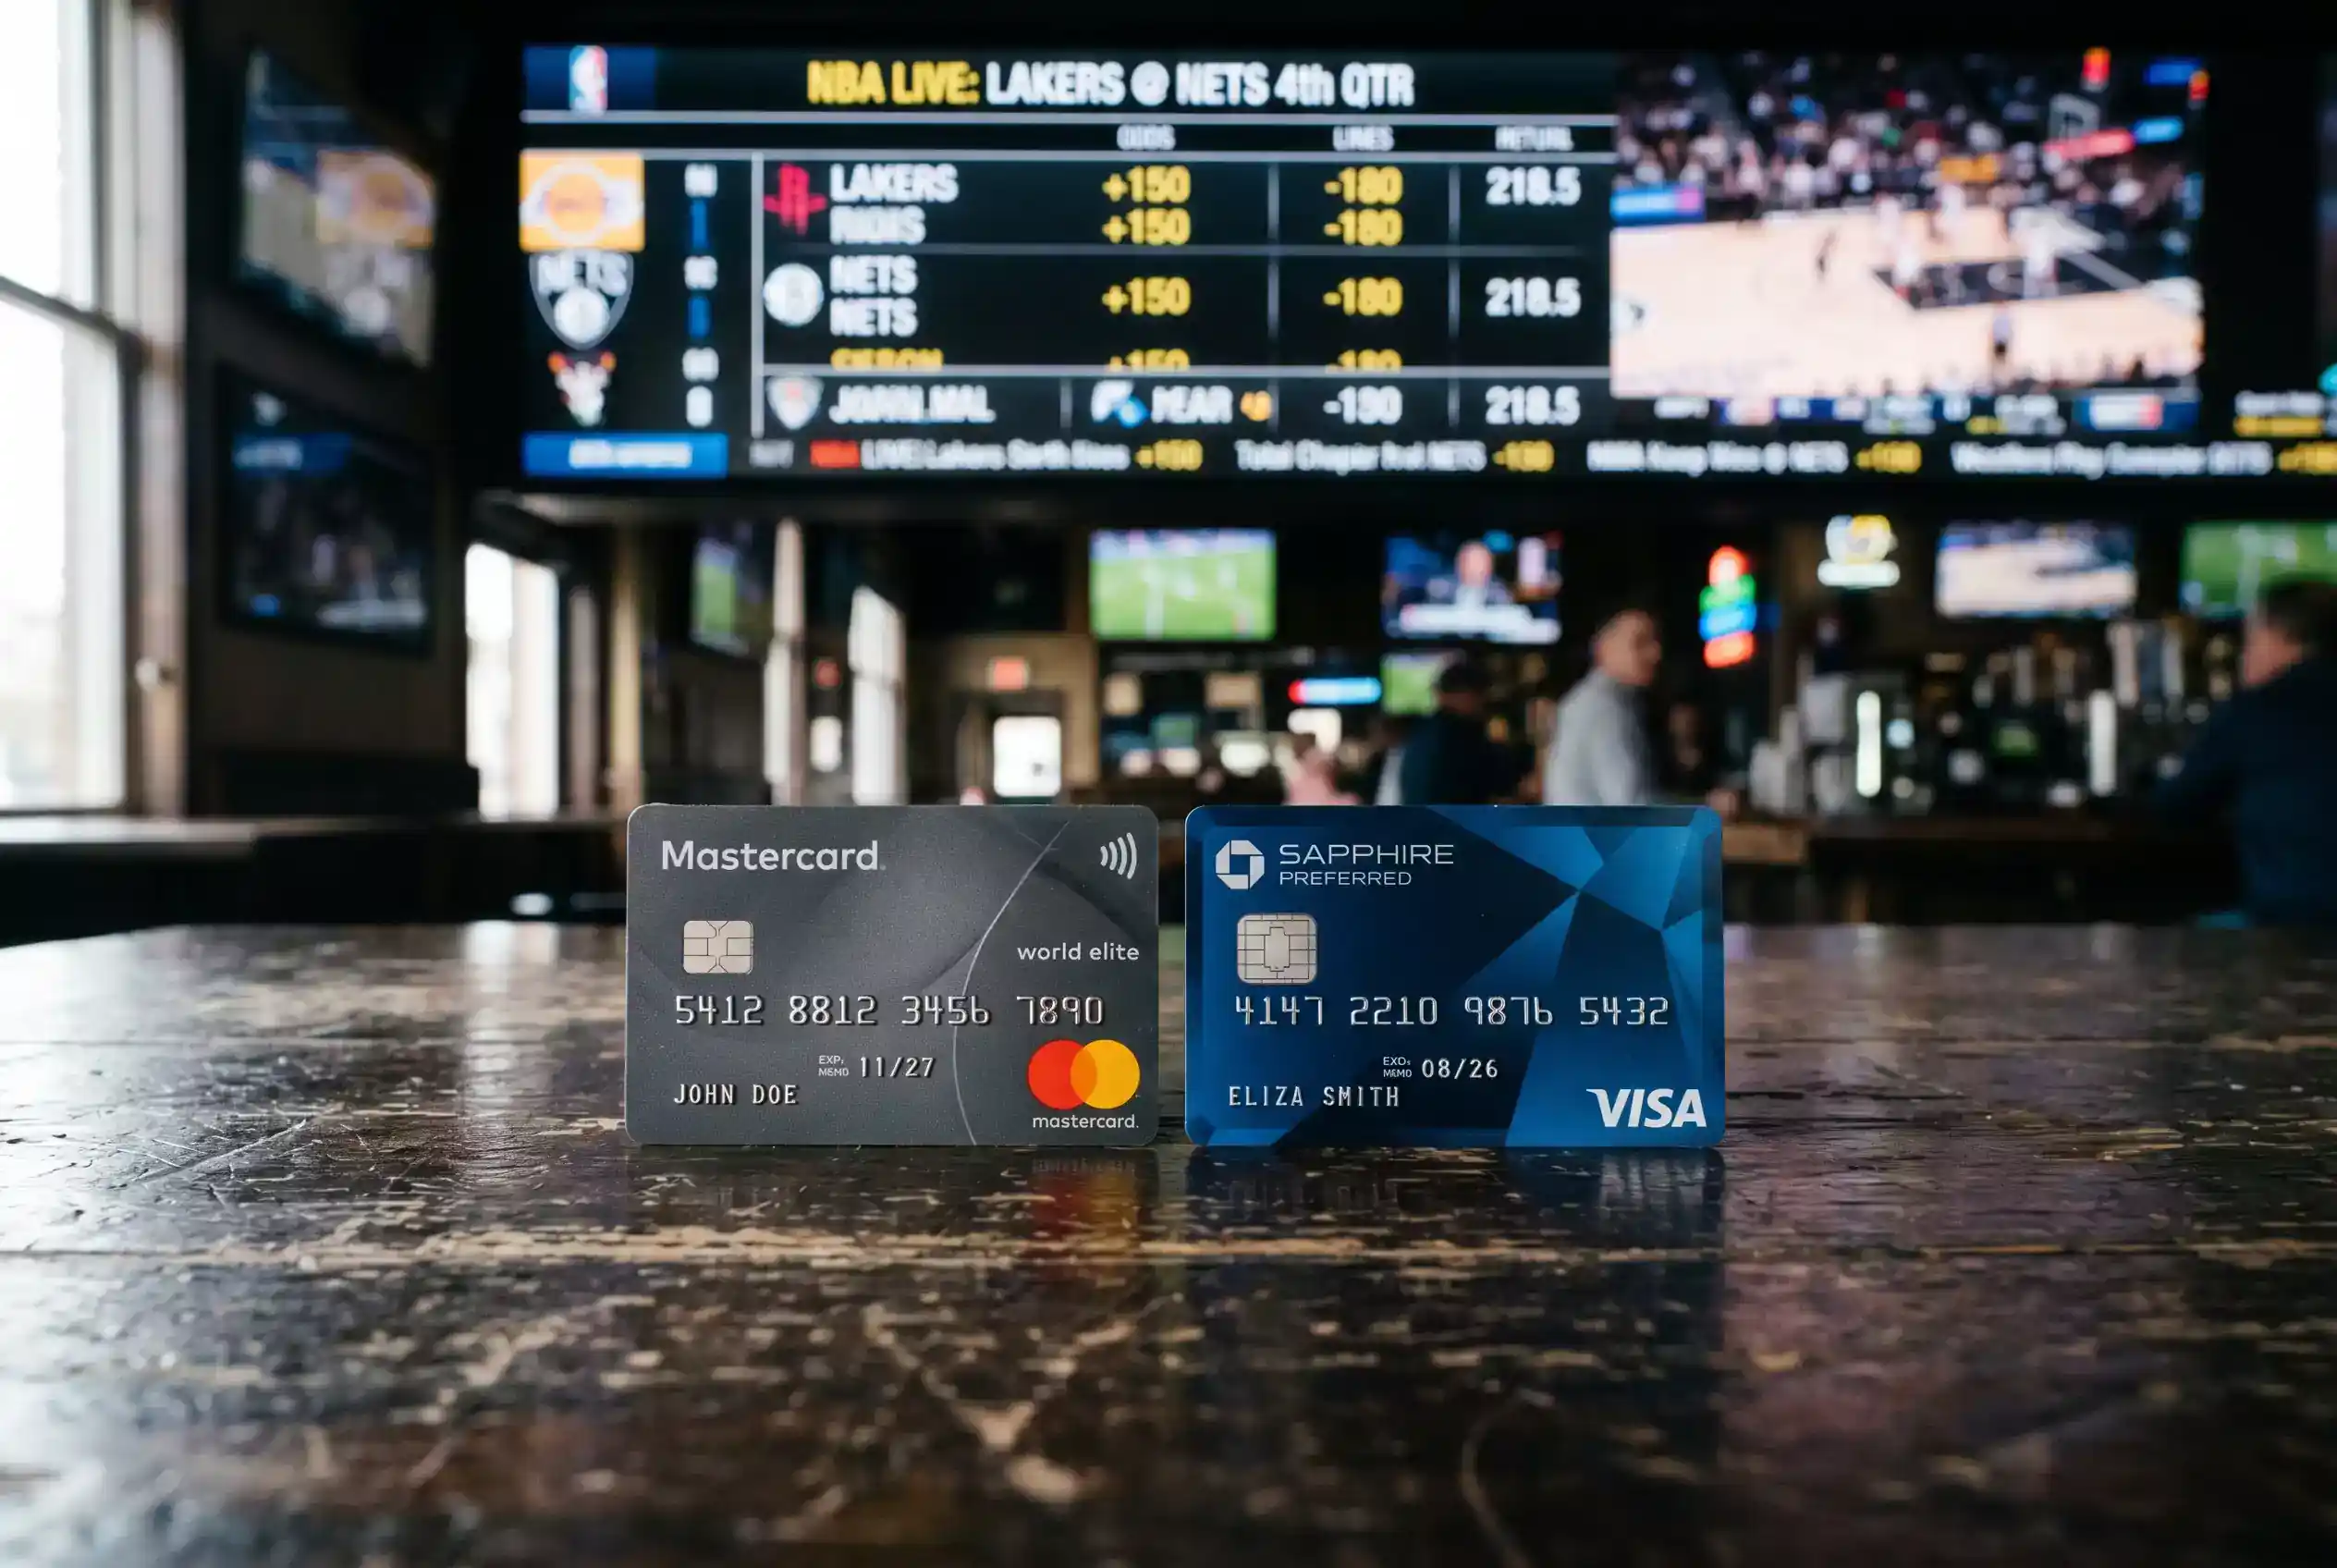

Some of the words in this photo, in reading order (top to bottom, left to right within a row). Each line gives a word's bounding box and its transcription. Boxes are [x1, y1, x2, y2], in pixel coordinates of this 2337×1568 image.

[807, 60, 886, 104] NBA
[891, 61, 980, 104] LIVE:
[985, 61, 1126, 106] LAKERS
[1175, 61, 1270, 106] NETS
[1274, 63, 1336, 106] 4th
[1340, 62, 1414, 109] QTR
[829, 164, 960, 202] LAKERS
[1102, 165, 1191, 203] +150
[1486, 166, 1581, 206] 218.5
[1102, 208, 1191, 248] +150
[829, 255, 918, 294] NETS
[1102, 276, 1191, 315] +150
[829, 298, 918, 337] NETS
[1279, 844, 1453, 864] SAPPHIRE
[1280, 872, 1411, 885] PREFERRED
[1018, 943, 1081, 960] world
[1090, 942, 1139, 960] elite
[676, 996, 761, 1023] 5412
[789, 996, 874, 1023] 8812
[902, 996, 987, 1023] 3456
[1017, 997, 1101, 1023] 7890
[1236, 997, 1322, 1024] 4147
[1351, 998, 1437, 1024] 2210
[1465, 997, 1552, 1024] 9876
[1581, 997, 1668, 1024] 5432
[861, 1057, 933, 1077] 11/27
[1422, 1059, 1497, 1079] 08/26
[674, 1084, 732, 1103] JOHN
[752, 1084, 795, 1104] DOE
[1229, 1085, 1304, 1107] ELIZA
[1324, 1086, 1398, 1106] SMITH
[1586, 1089, 1706, 1127] VISA
